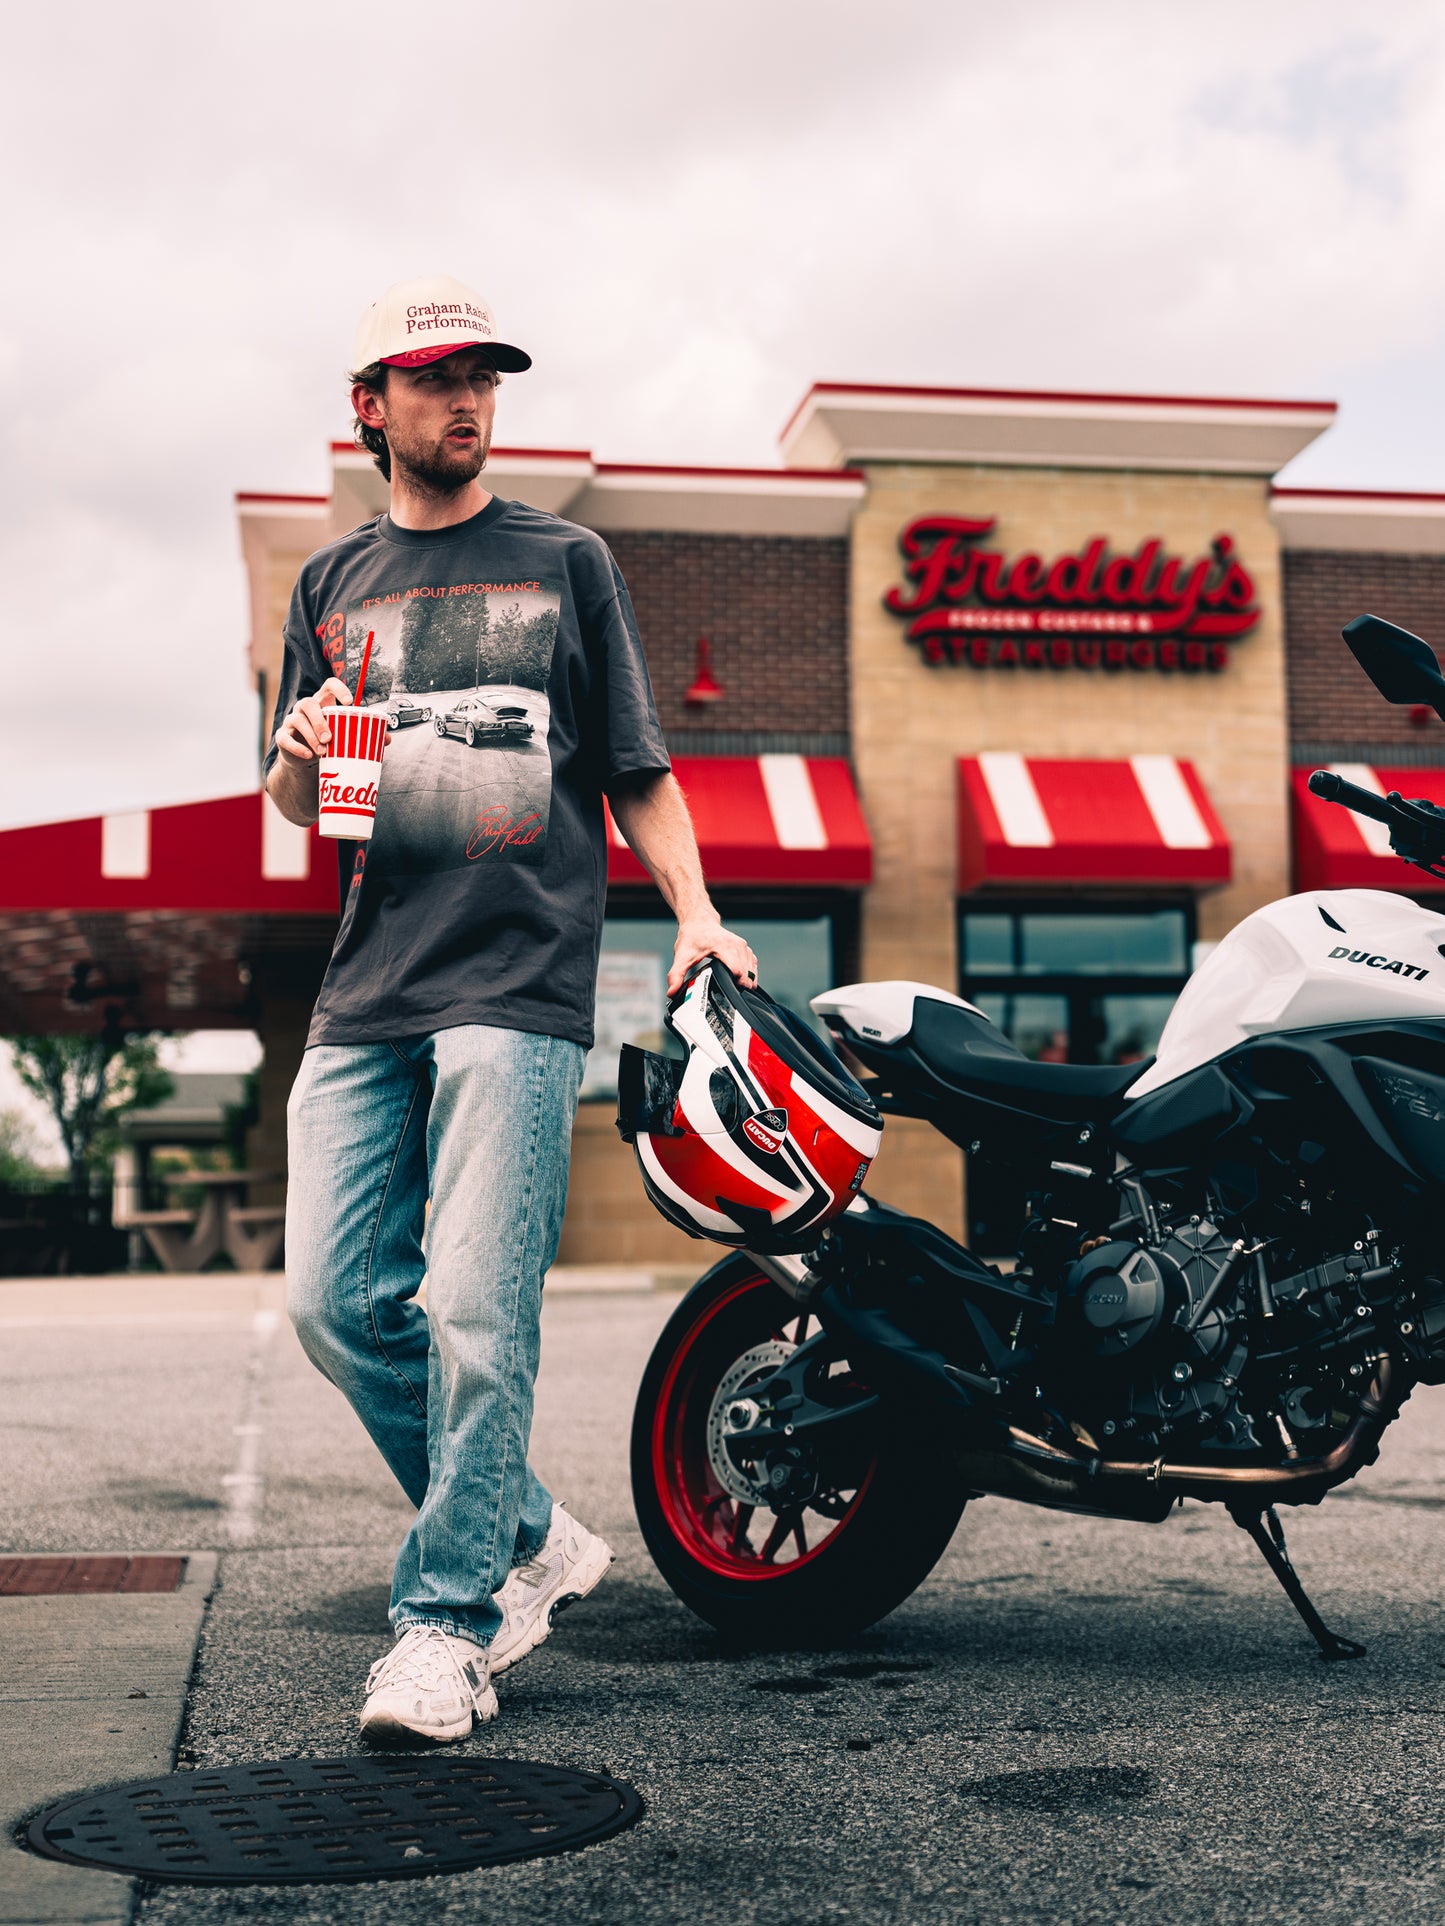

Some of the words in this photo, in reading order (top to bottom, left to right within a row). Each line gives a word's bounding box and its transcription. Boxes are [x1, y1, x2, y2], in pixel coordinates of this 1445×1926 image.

[407, 302, 462, 318] Graham
[884, 514, 1258, 618] Freddy's
[362, 598, 381, 610] IT'S
[383, 592, 401, 604] ALL
[404, 586, 447, 600] ABOUT
[448, 581, 544, 597] PERFORMANCE.
[922, 637, 1229, 670] STEAKBURGERS
[1327, 946, 1430, 981] DUCATI
[862, 1026, 881, 1038] DUCATI
[746, 1122, 777, 1150] DUCATI
